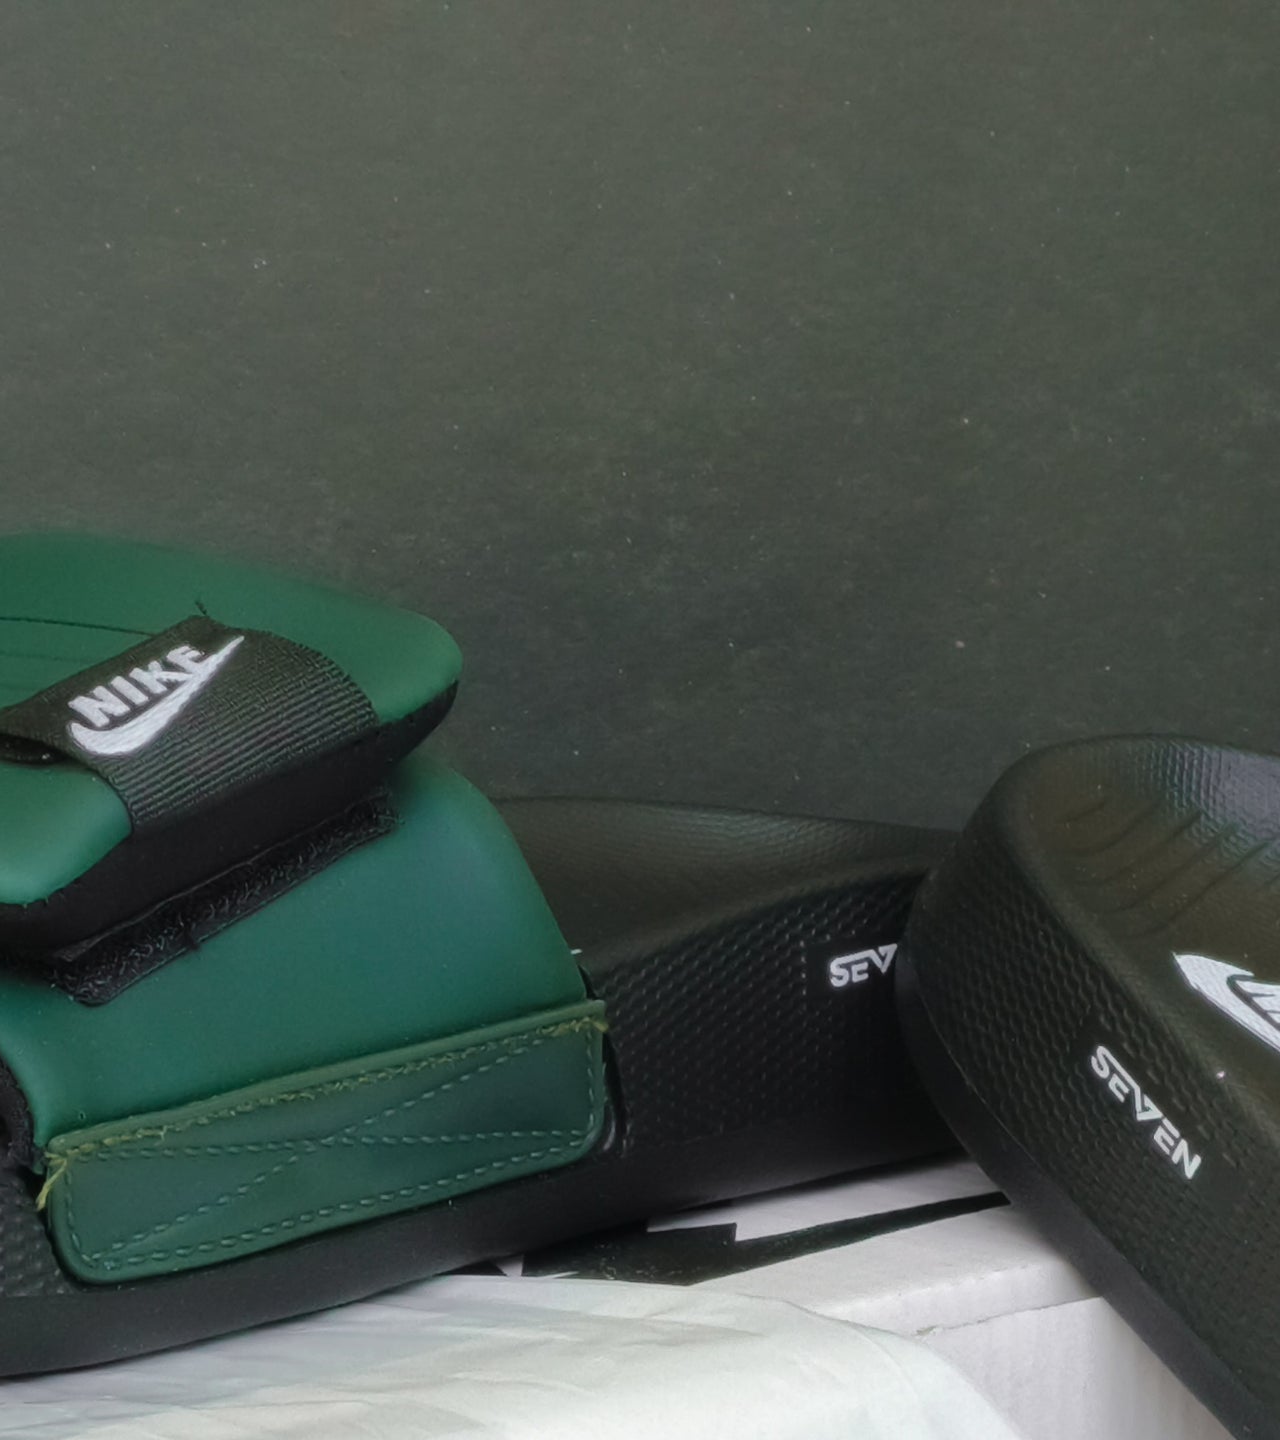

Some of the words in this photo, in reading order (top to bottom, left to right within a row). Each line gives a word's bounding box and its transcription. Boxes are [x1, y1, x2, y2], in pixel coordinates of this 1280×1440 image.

[68, 644, 206, 727] NIKE
[830, 943, 898, 987] SEV
[1090, 1045, 1202, 1180] SEVEN
